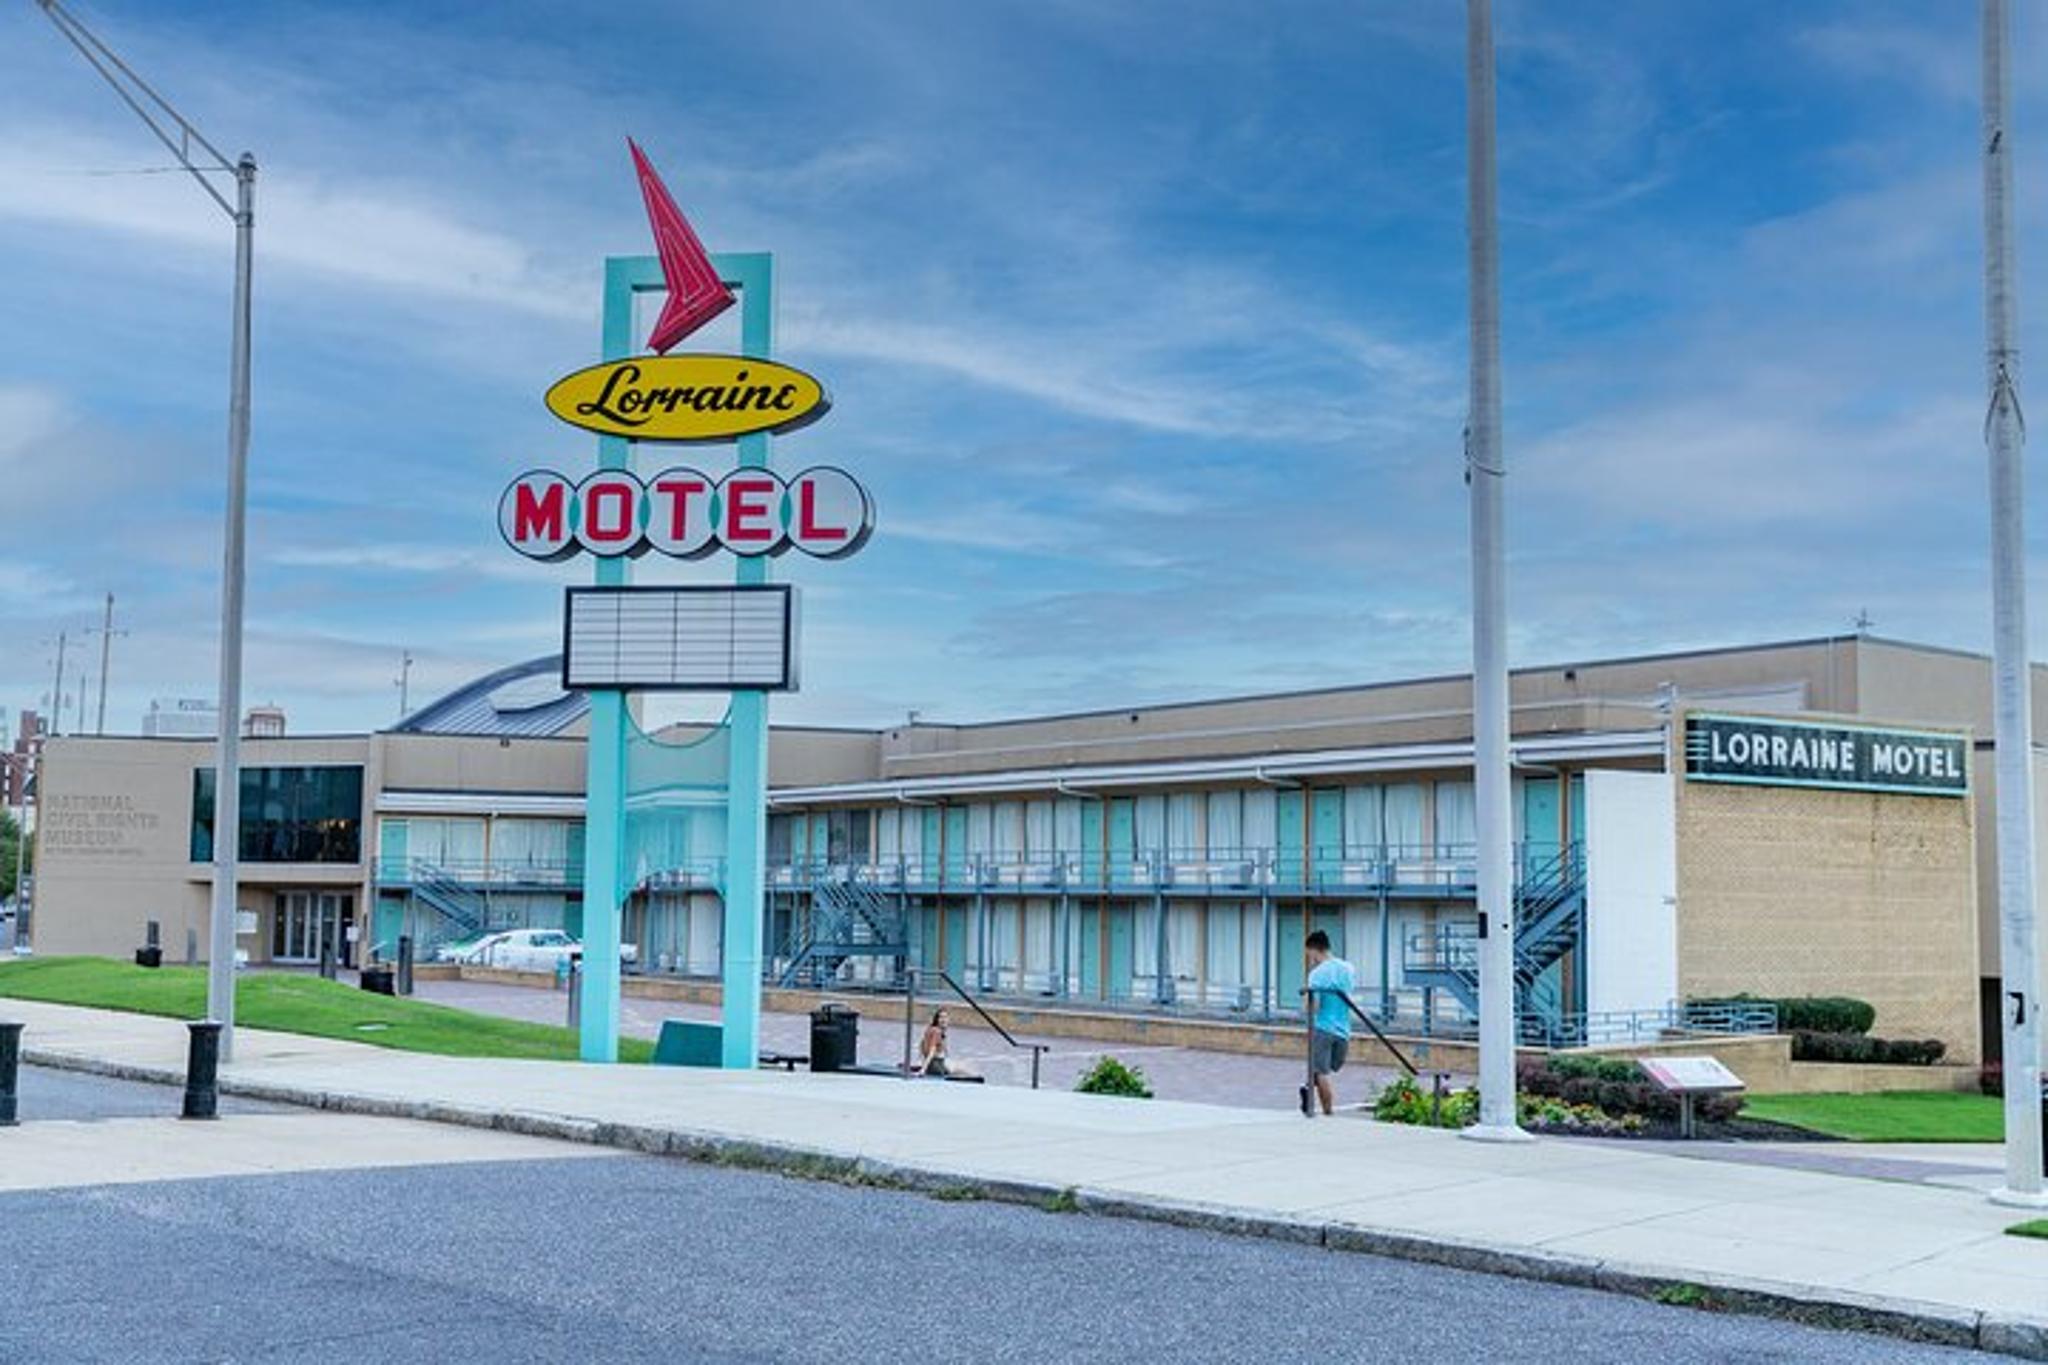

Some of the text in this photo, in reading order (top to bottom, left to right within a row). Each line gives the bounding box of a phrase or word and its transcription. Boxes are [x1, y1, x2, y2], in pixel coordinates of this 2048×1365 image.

[577, 365, 798, 426] Lorraine
[514, 480, 847, 542] MOTEL
[1711, 731, 1961, 777] LORRAINE MOTEL
[46, 795, 135, 811] NATIONAL
